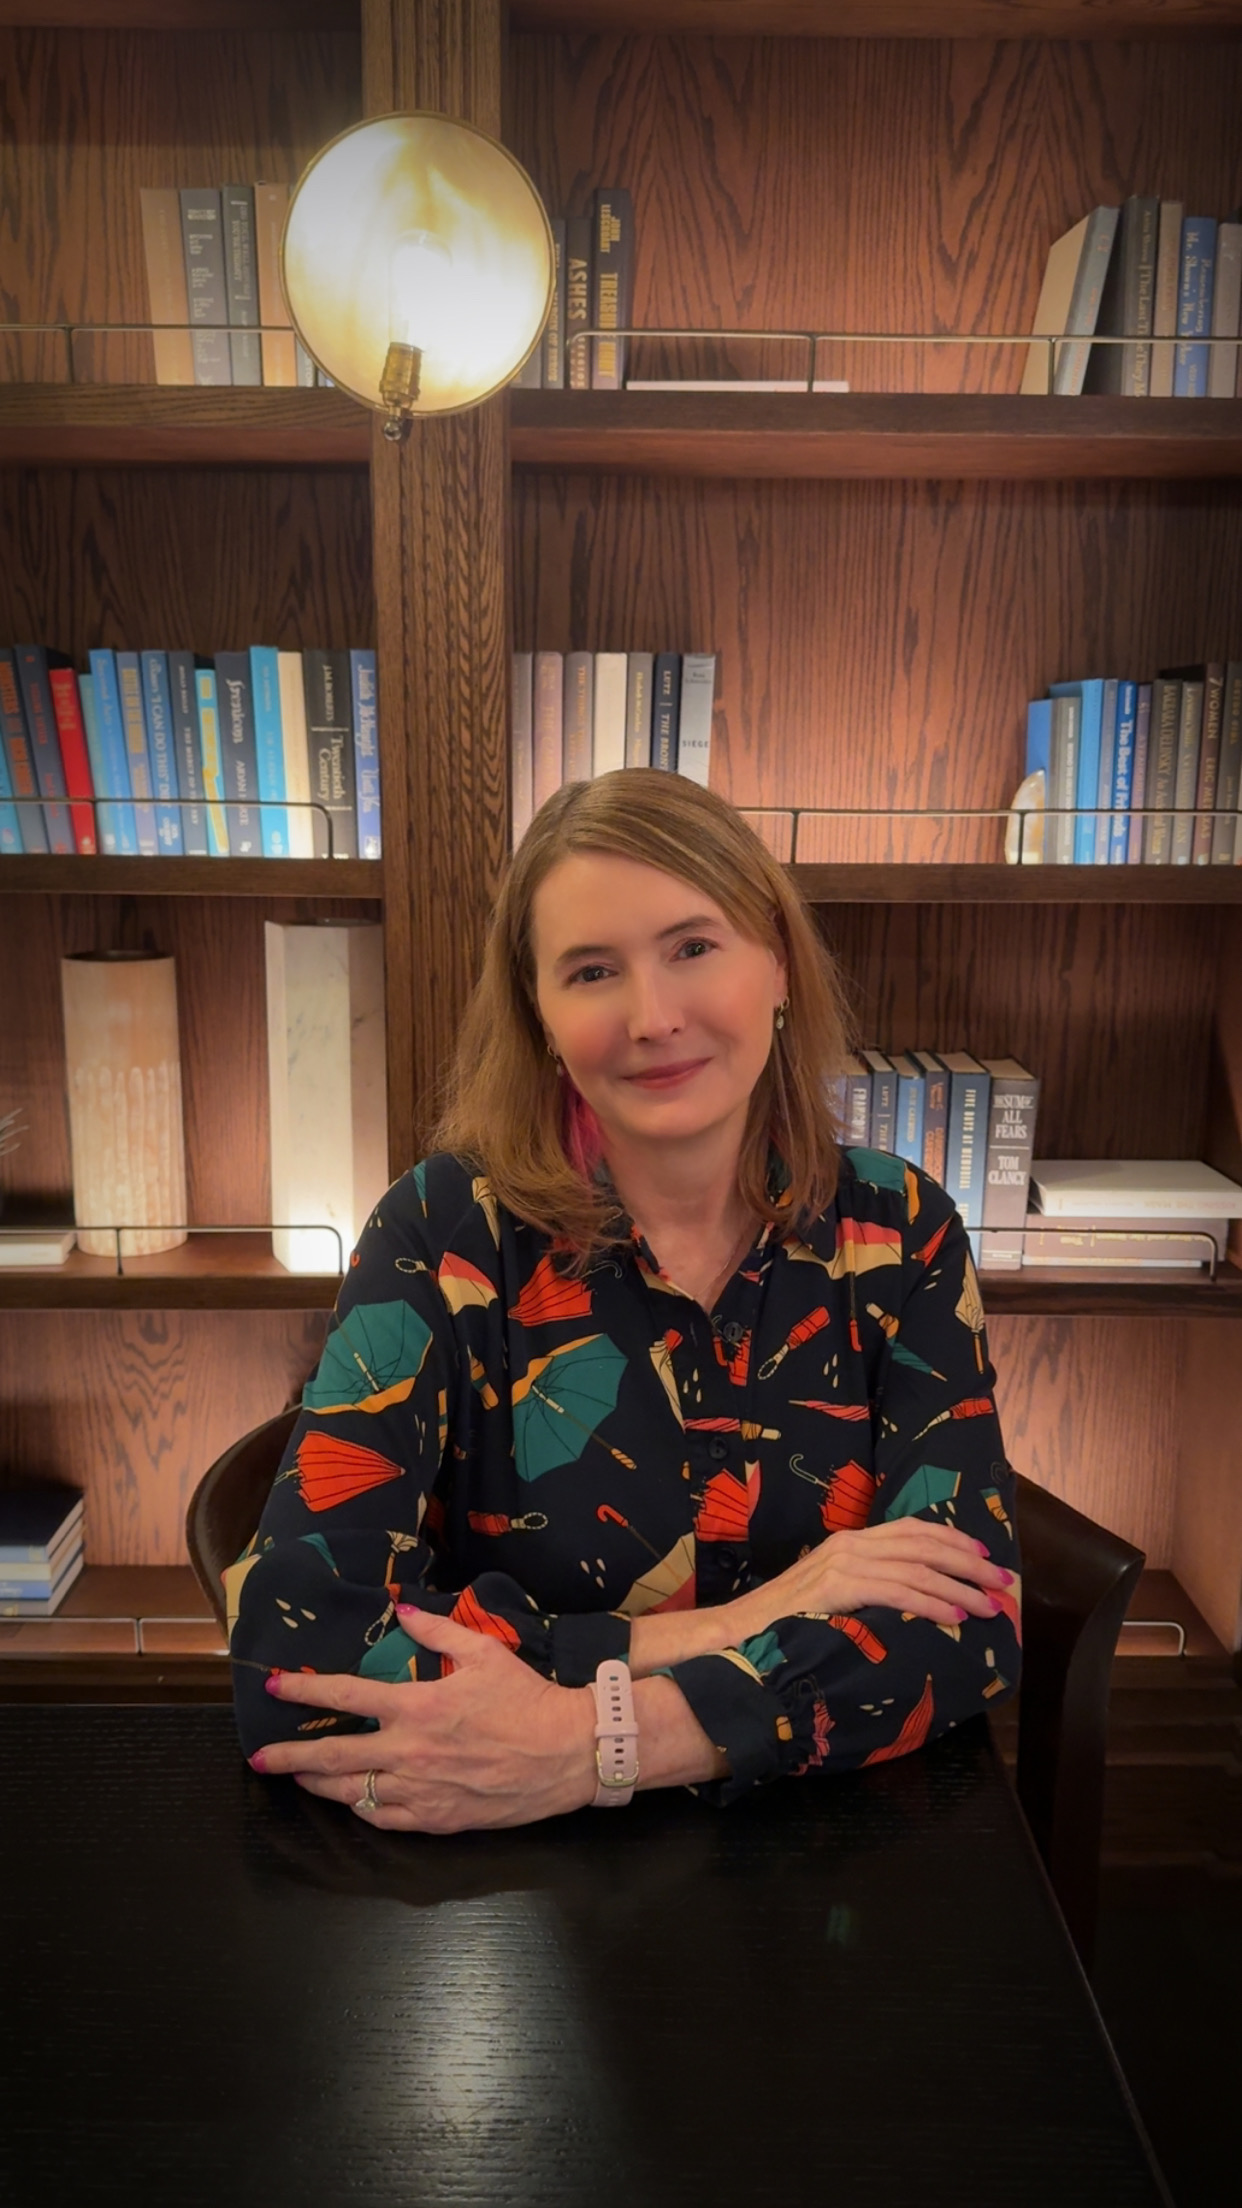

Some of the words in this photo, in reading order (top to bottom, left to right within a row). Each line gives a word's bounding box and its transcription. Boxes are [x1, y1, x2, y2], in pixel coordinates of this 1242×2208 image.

[600, 204, 611, 254] LESCROART
[611, 215, 621, 242] JOHN
[1185, 231, 1199, 251] Mr.
[568, 258, 588, 320] ASHES
[1139, 271, 1152, 295] The
[1196, 258, 1212, 333] Remembering
[599, 272, 618, 338] TREASUR
[1137, 296, 1150, 319] Last
[1181, 302, 1196, 325] New
[1135, 321, 1149, 354] Tie
[1179, 330, 1194, 366] Yrker
[598, 341, 617, 378] HUNT
[1131, 352, 1148, 381] They
[357, 665, 375, 700] Judith
[663, 670, 672, 696] LUTZ
[1208, 677, 1224, 687] 7
[153, 705, 164, 730] CAN
[1160, 684, 1177, 728] BARBARA
[1207, 688, 1221, 739] WOMEN
[660, 714, 671, 736] THE
[1119, 719, 1133, 745] The
[155, 733, 167, 751] DO
[682, 739, 709, 748] SIEGE
[1157, 728, 1174, 777] DELINSKY
[185, 746, 194, 775] MERCY
[331, 736, 345, 800] Twentieth
[1117, 747, 1130, 776] Best
[1204, 757, 1216, 783] ERIC
[236, 760, 247, 792] AIDAN
[317, 748, 332, 802] Century
[1116, 777, 1130, 791] of
[159, 783, 171, 808] DIT
[1113, 791, 1128, 837] Frinds
[1201, 786, 1214, 839] METXAS
[964, 1088, 977, 1108] FIVE
[1001, 1095, 1025, 1110] SUM
[962, 1110, 976, 1132] DAYS
[1001, 1110, 1023, 1124] ALL
[962, 1134, 974, 1145] AT
[995, 1124, 1028, 1139] FEARS
[958, 1147, 973, 1189] MEMORIAL
[997, 1156, 1019, 1170] TOM
[988, 1170, 1027, 1186] CLANCY
